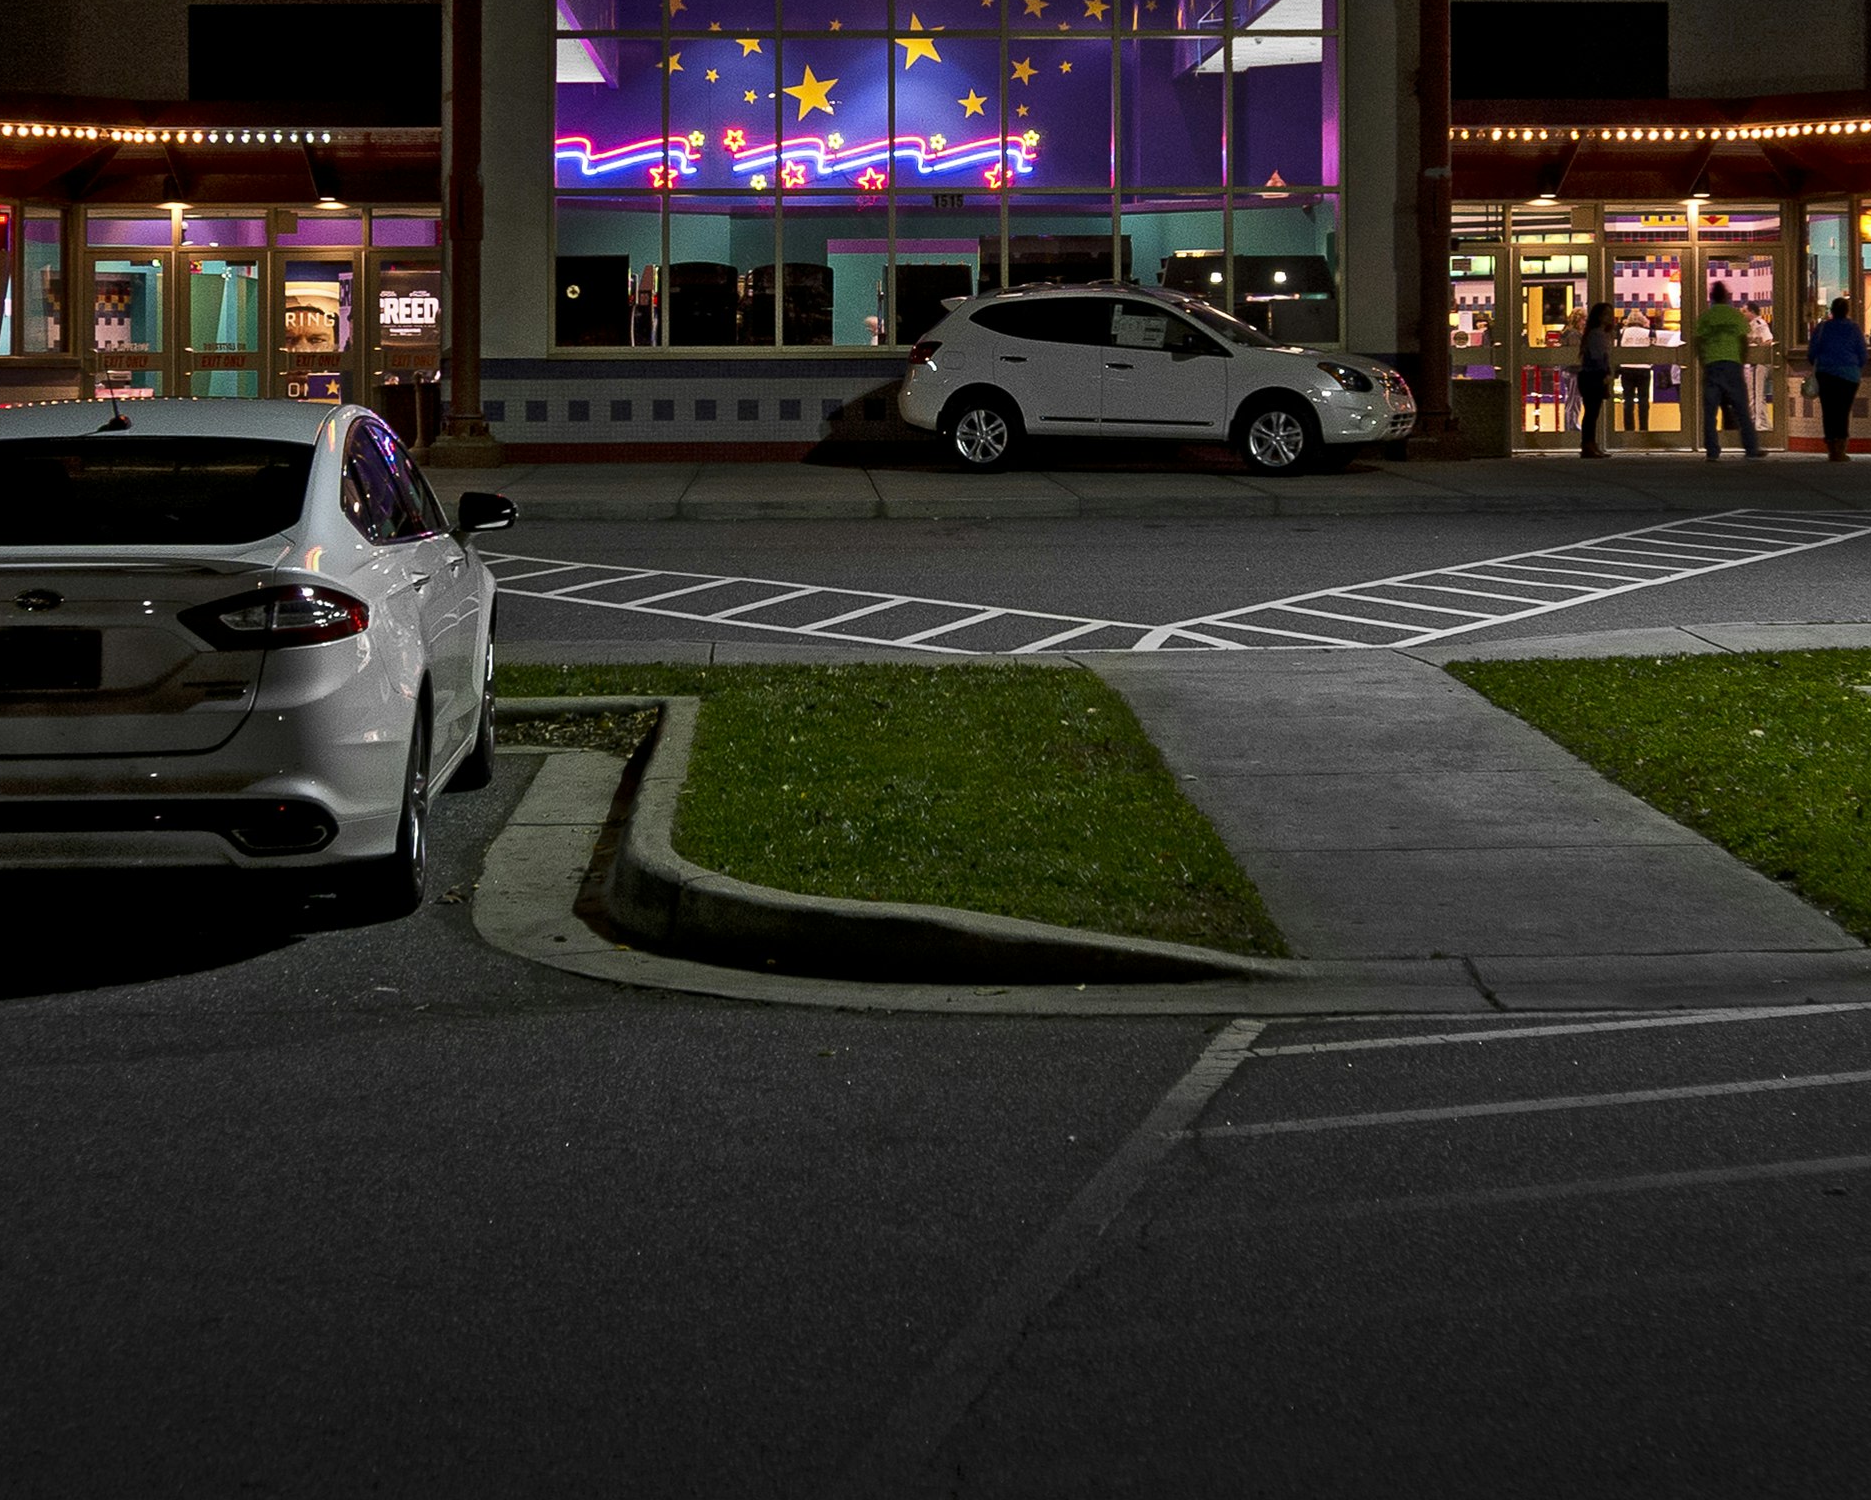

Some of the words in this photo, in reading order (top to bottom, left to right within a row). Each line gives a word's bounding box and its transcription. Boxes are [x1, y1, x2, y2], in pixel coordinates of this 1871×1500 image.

[104, 356, 123, 368] EXIT
[126, 356, 148, 368] ONLY
[201, 355, 221, 368] EXIT
[223, 355, 246, 368] ONLY
[296, 354, 316, 367] EXIT
[318, 354, 341, 367] ONLY
